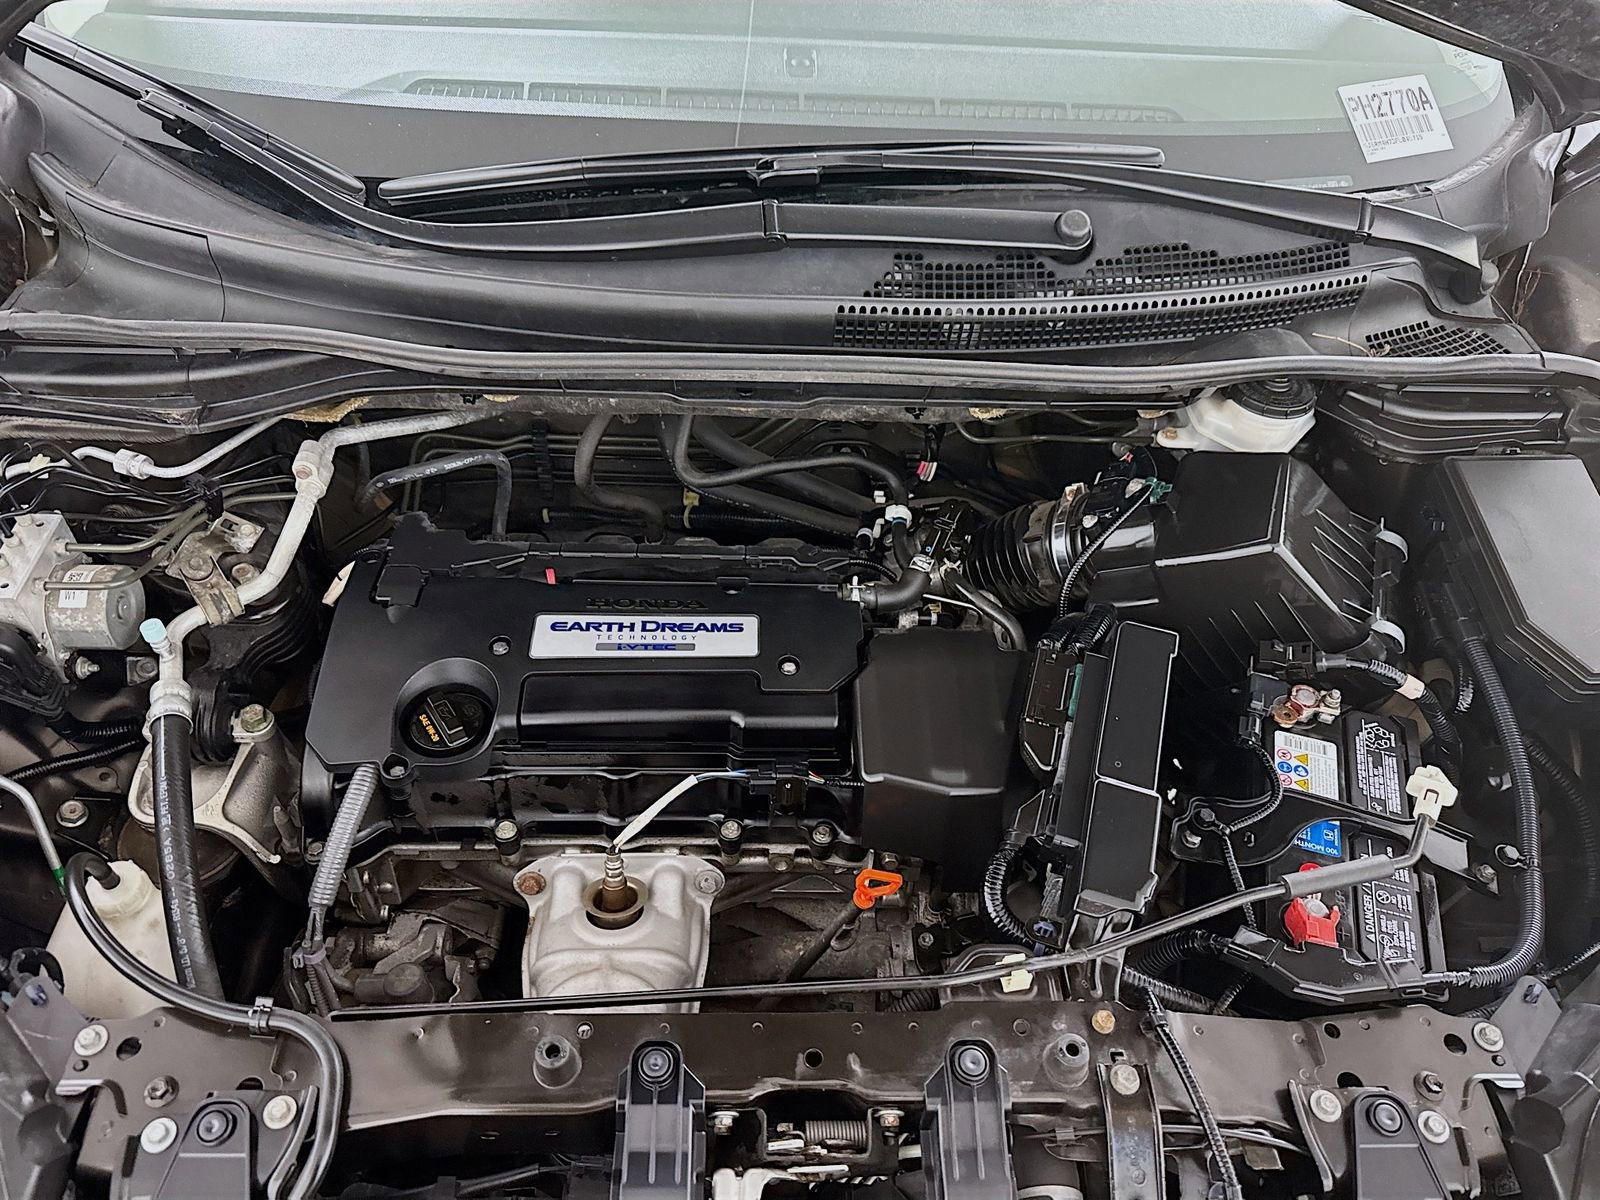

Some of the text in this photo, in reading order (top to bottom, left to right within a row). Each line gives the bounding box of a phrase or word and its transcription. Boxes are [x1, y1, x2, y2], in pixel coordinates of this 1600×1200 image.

[1347, 86, 1434, 122] PH2770A
[585, 598, 709, 610] HONDA
[550, 620, 745, 633] EARTH DREAMS
[419, 713, 428, 727] SAE
[1325, 847, 1339, 855] 100
[163, 837, 176, 881] 0285A
[1363, 895, 1375, 932] DANGER
